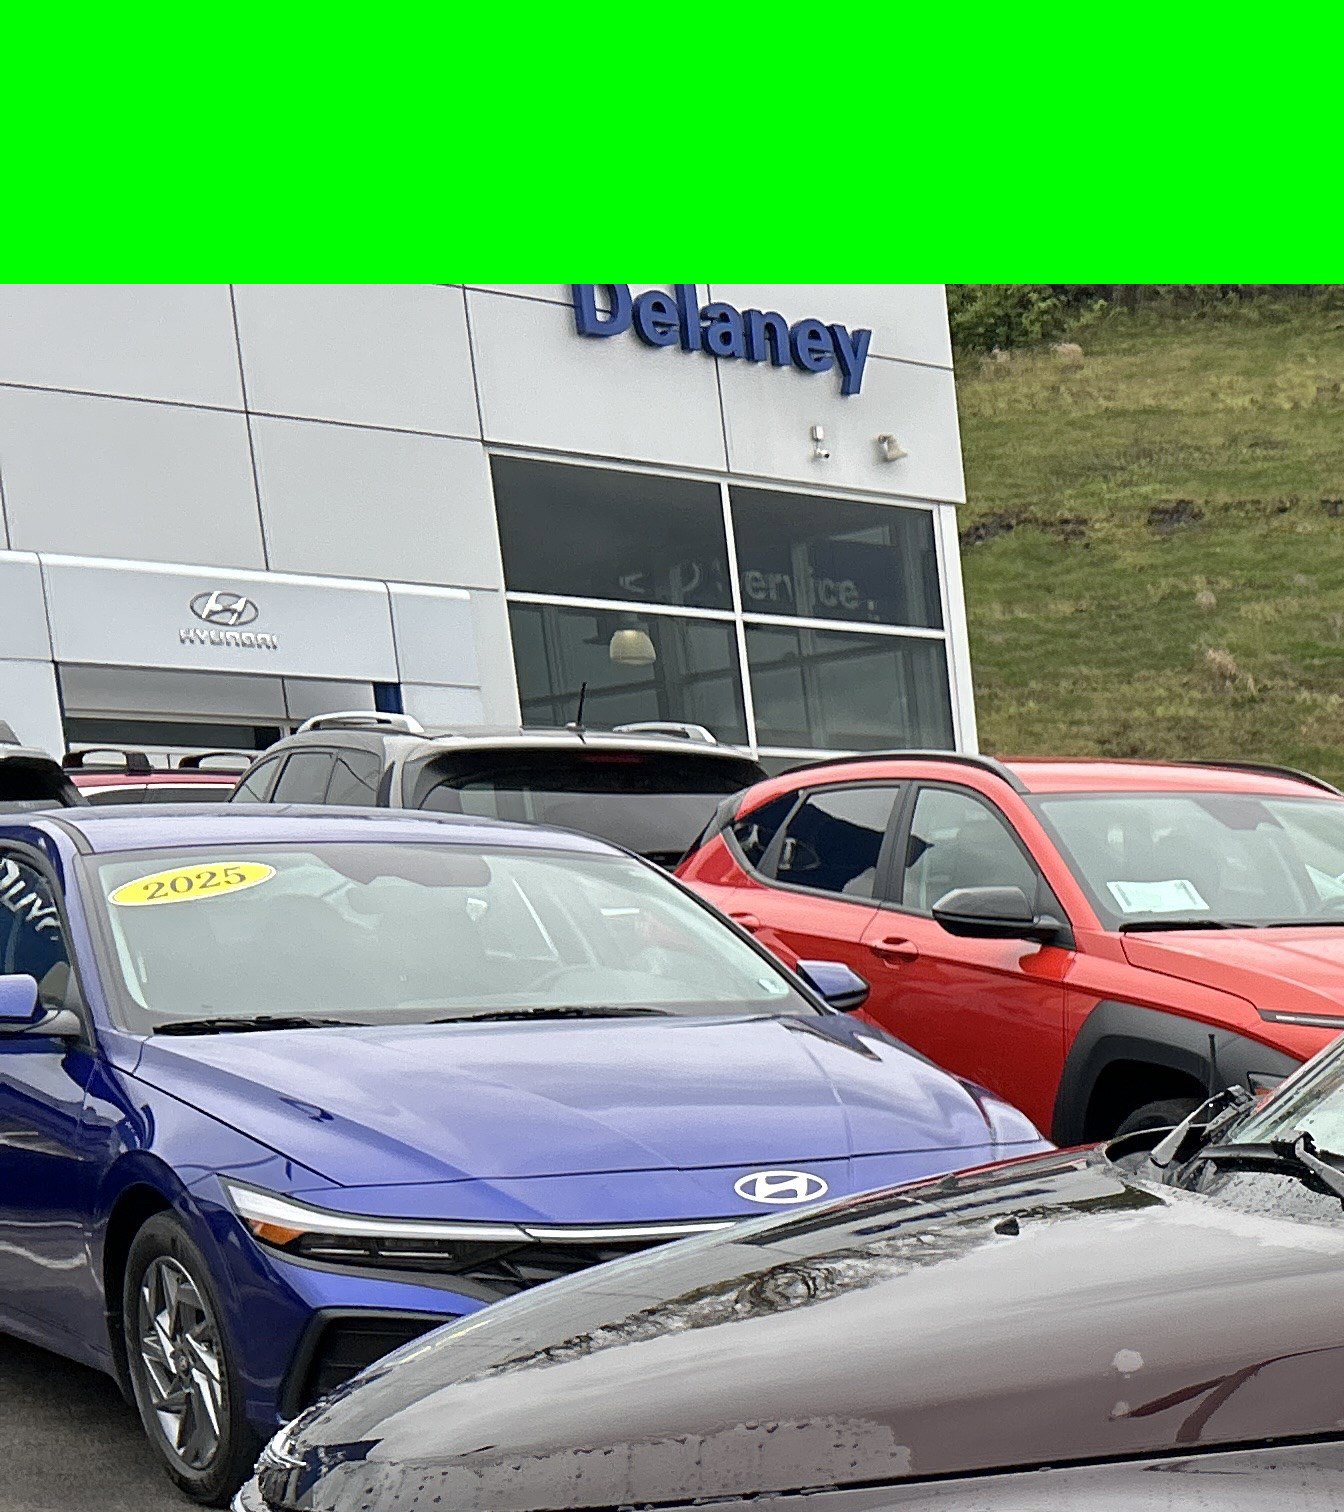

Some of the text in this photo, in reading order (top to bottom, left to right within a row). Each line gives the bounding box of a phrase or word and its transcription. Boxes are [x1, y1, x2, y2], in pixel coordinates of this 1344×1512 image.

[571, 284, 873, 395] Delaney
[179, 628, 279, 650] HYUNDAI
[142, 866, 247, 901] 2025
